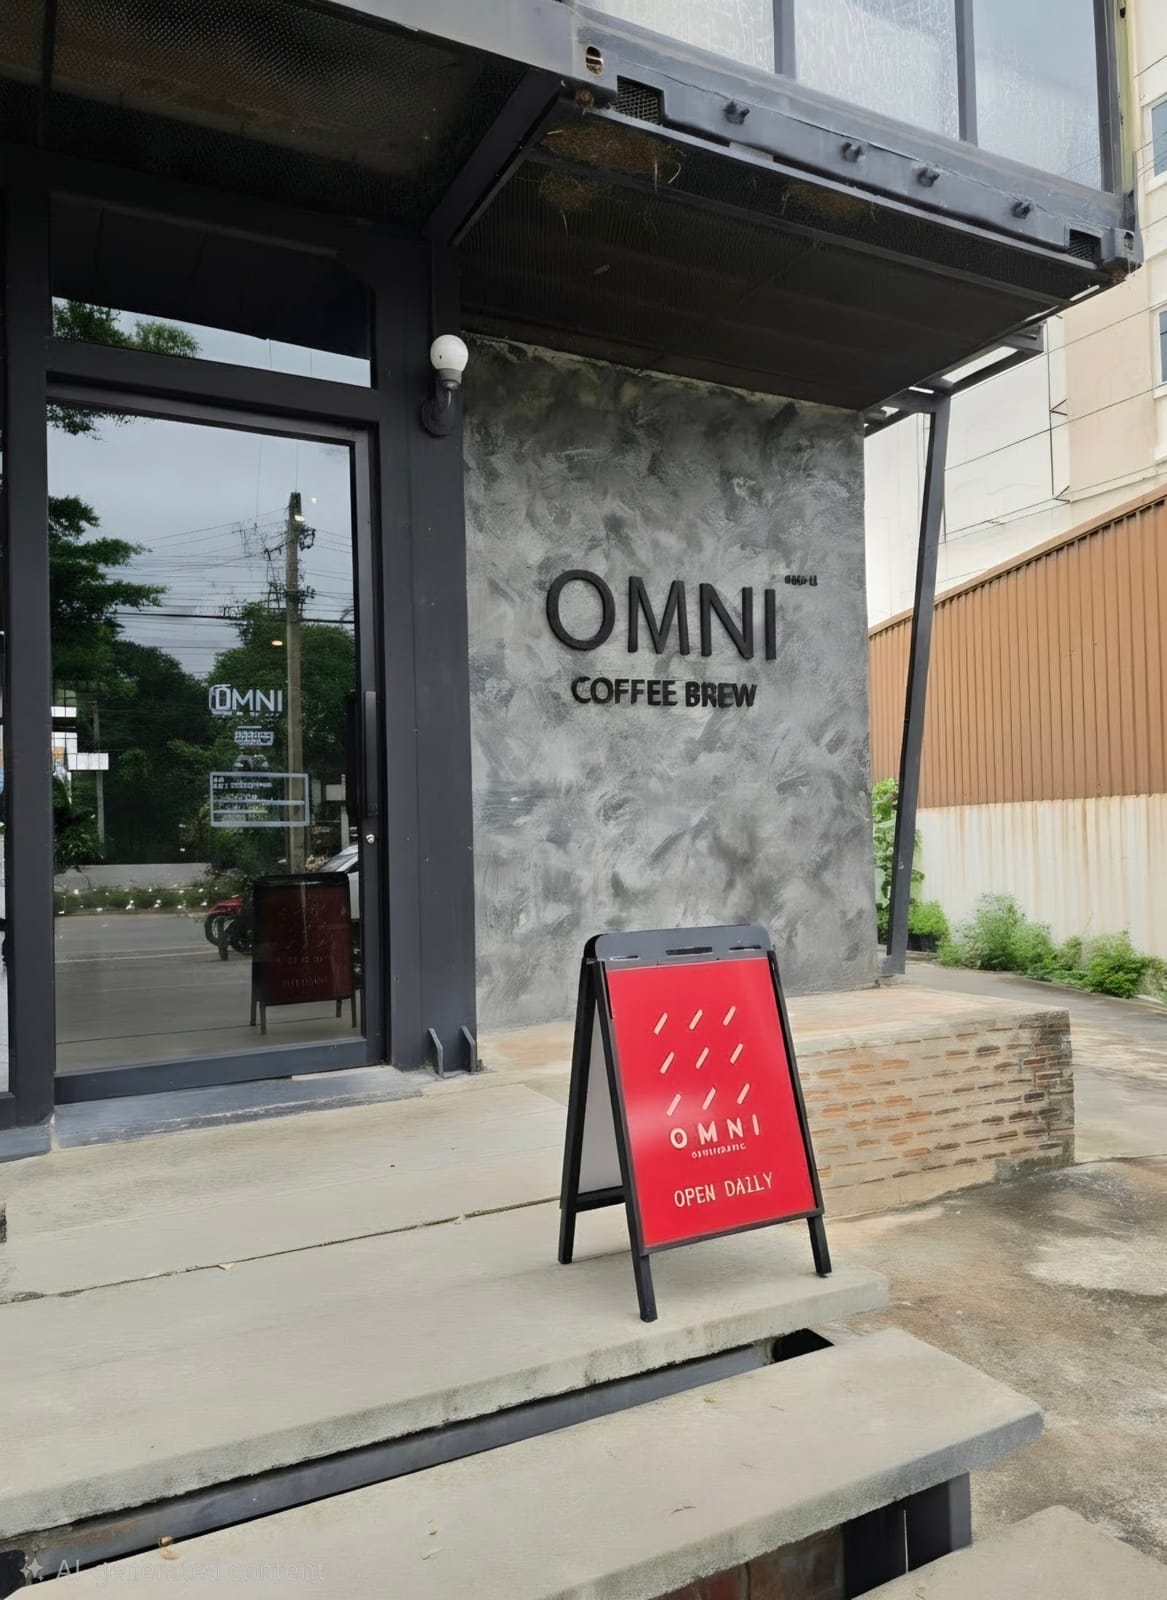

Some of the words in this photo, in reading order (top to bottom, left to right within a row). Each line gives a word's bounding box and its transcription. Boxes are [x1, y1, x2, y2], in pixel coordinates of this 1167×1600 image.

[546, 569, 777, 661] OMNI
[209, 684, 283, 715] OMNI
[571, 676, 678, 706] COFFEE
[685, 680, 758, 708] BREW
[670, 1114, 760, 1149] OMNI
[674, 1183, 717, 1208] OPEN
